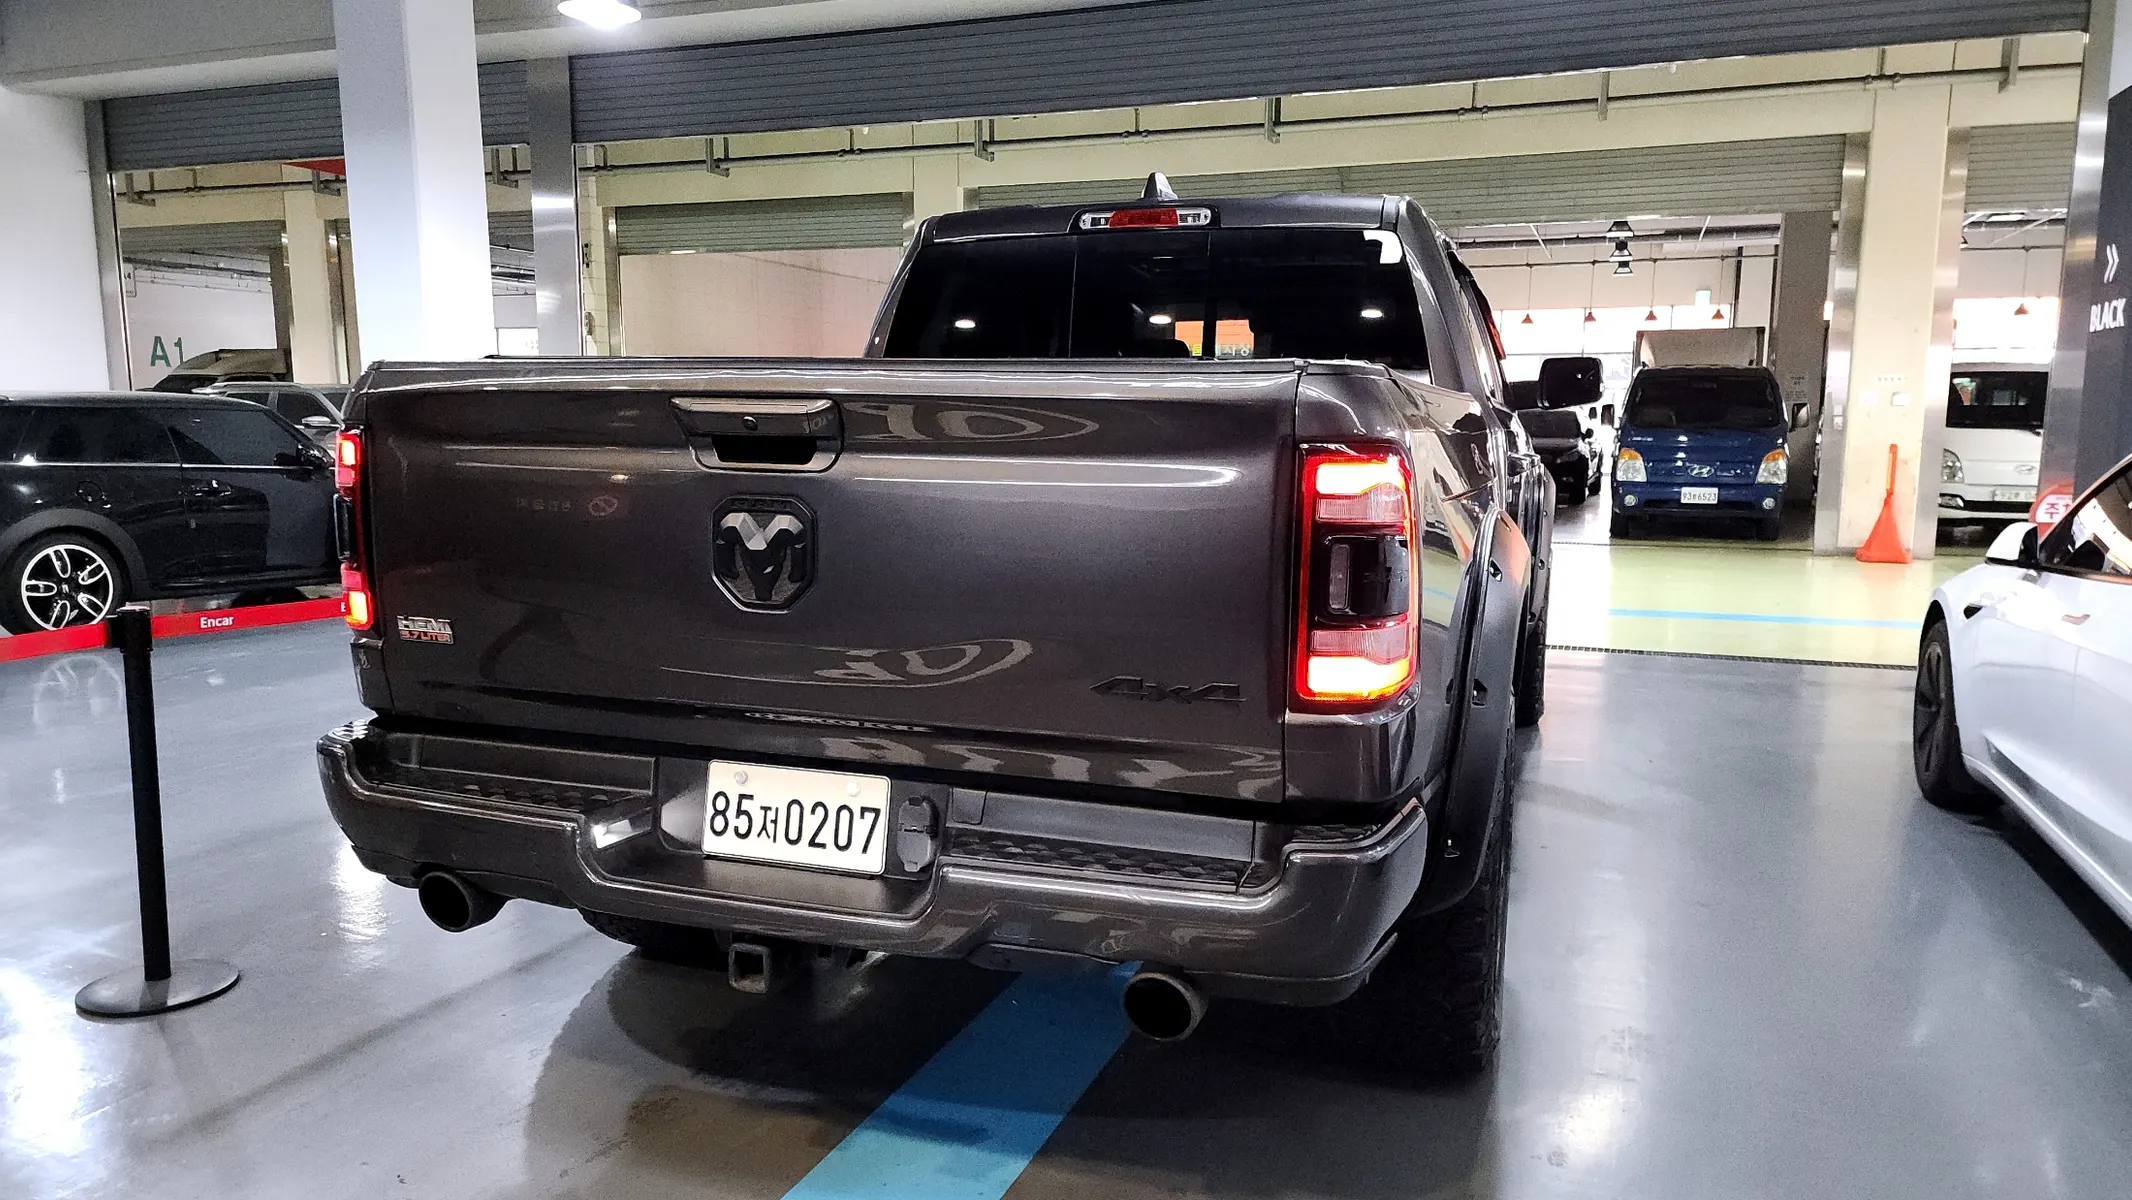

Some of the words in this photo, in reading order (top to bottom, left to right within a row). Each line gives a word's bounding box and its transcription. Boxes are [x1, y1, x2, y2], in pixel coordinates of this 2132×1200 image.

[2089, 298, 2126, 332] BLACK
[150, 335, 184, 367] A1
[200, 616, 234, 629] Encar
[396, 615, 452, 633] HEMI
[420, 631, 451, 642] LITER
[709, 790, 882, 855] 85저0207
